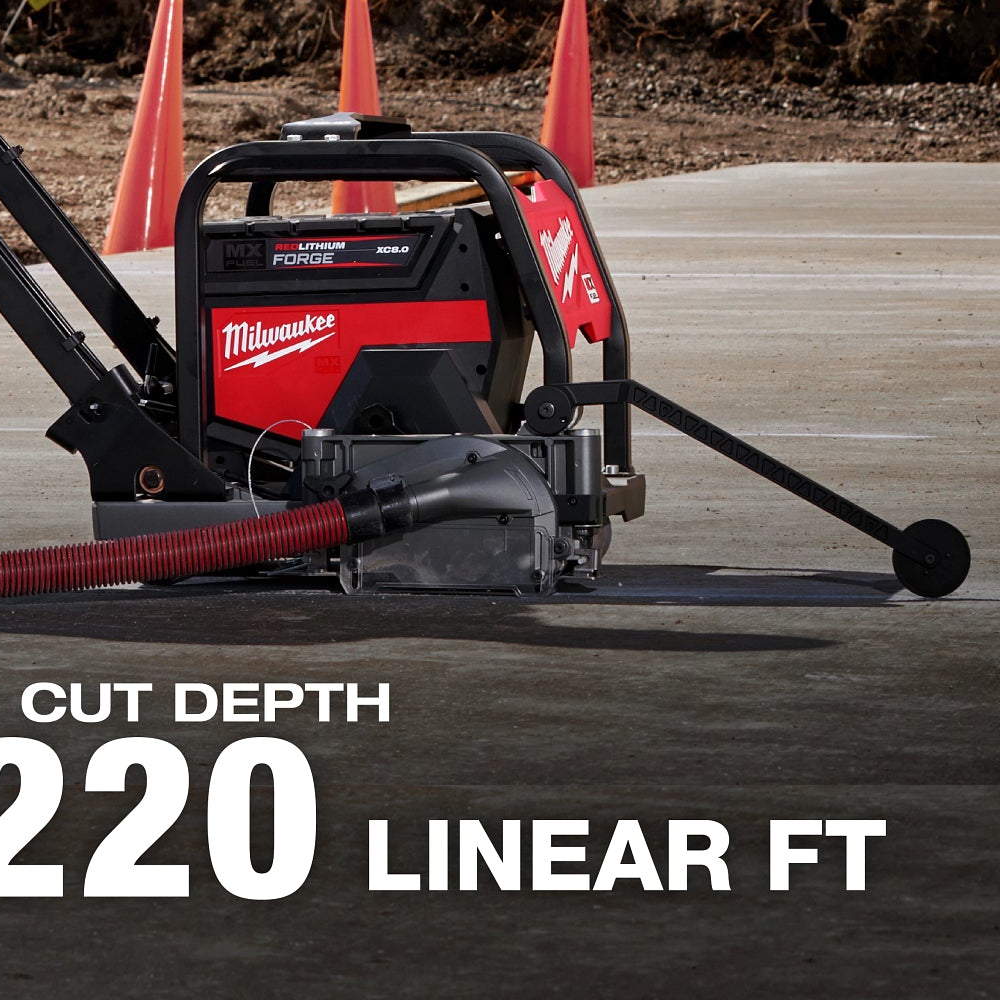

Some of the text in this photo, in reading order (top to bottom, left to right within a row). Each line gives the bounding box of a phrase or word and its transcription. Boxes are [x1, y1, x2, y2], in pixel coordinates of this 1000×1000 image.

[226, 244, 263, 257] MX
[273, 253, 334, 265] FORGE
[222, 313, 335, 359] Milwaukee
